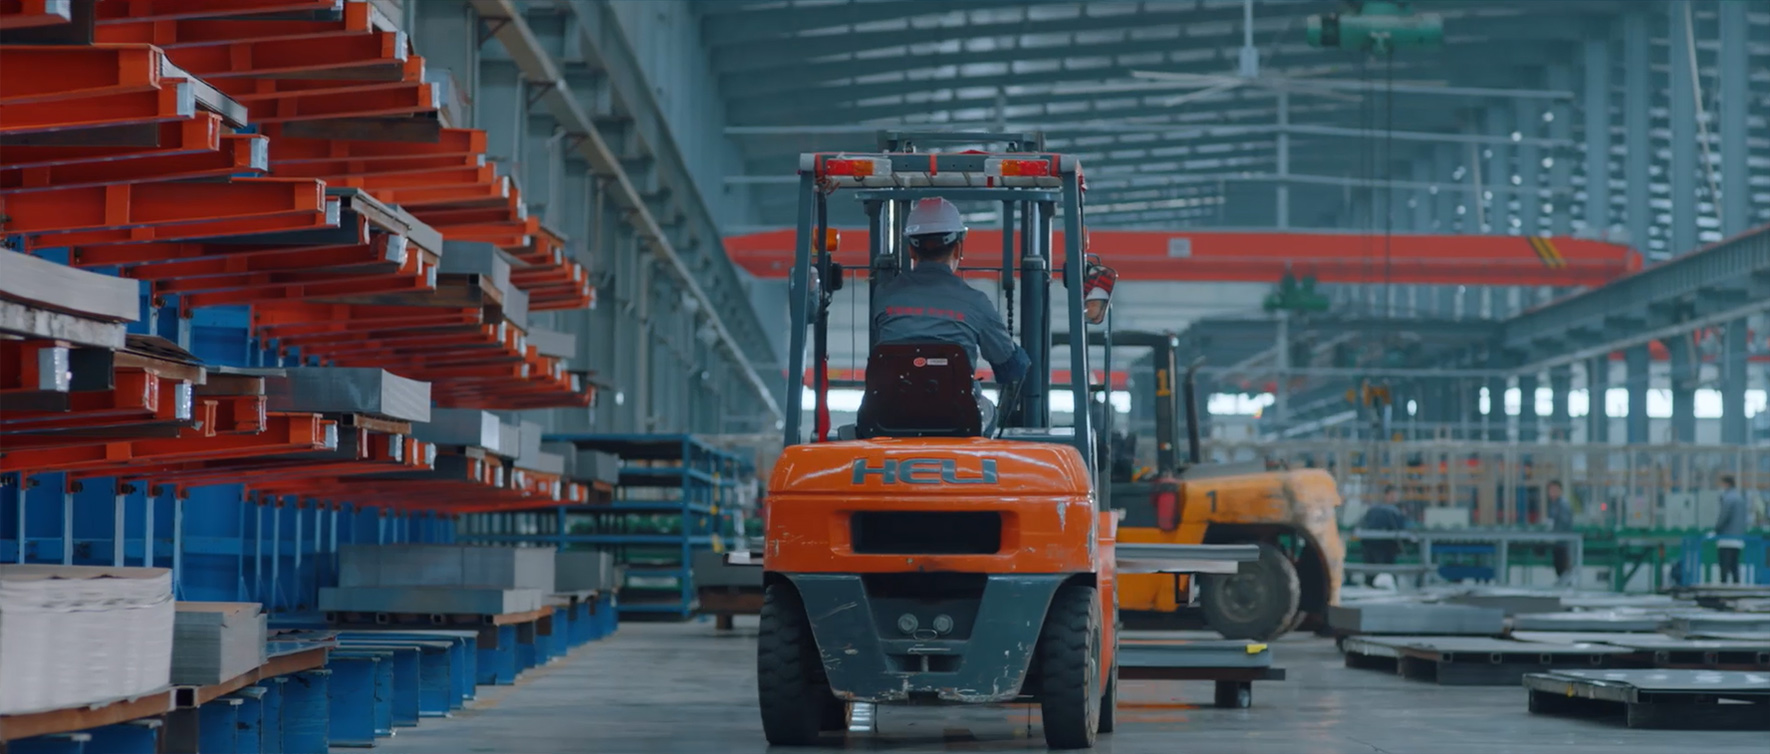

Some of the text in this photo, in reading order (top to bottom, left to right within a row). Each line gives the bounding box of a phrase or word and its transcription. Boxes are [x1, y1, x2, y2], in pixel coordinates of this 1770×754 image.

[1156, 369, 1170, 396] 1
[852, 458, 997, 484] HELI
[1206, 490, 1217, 513] 1
